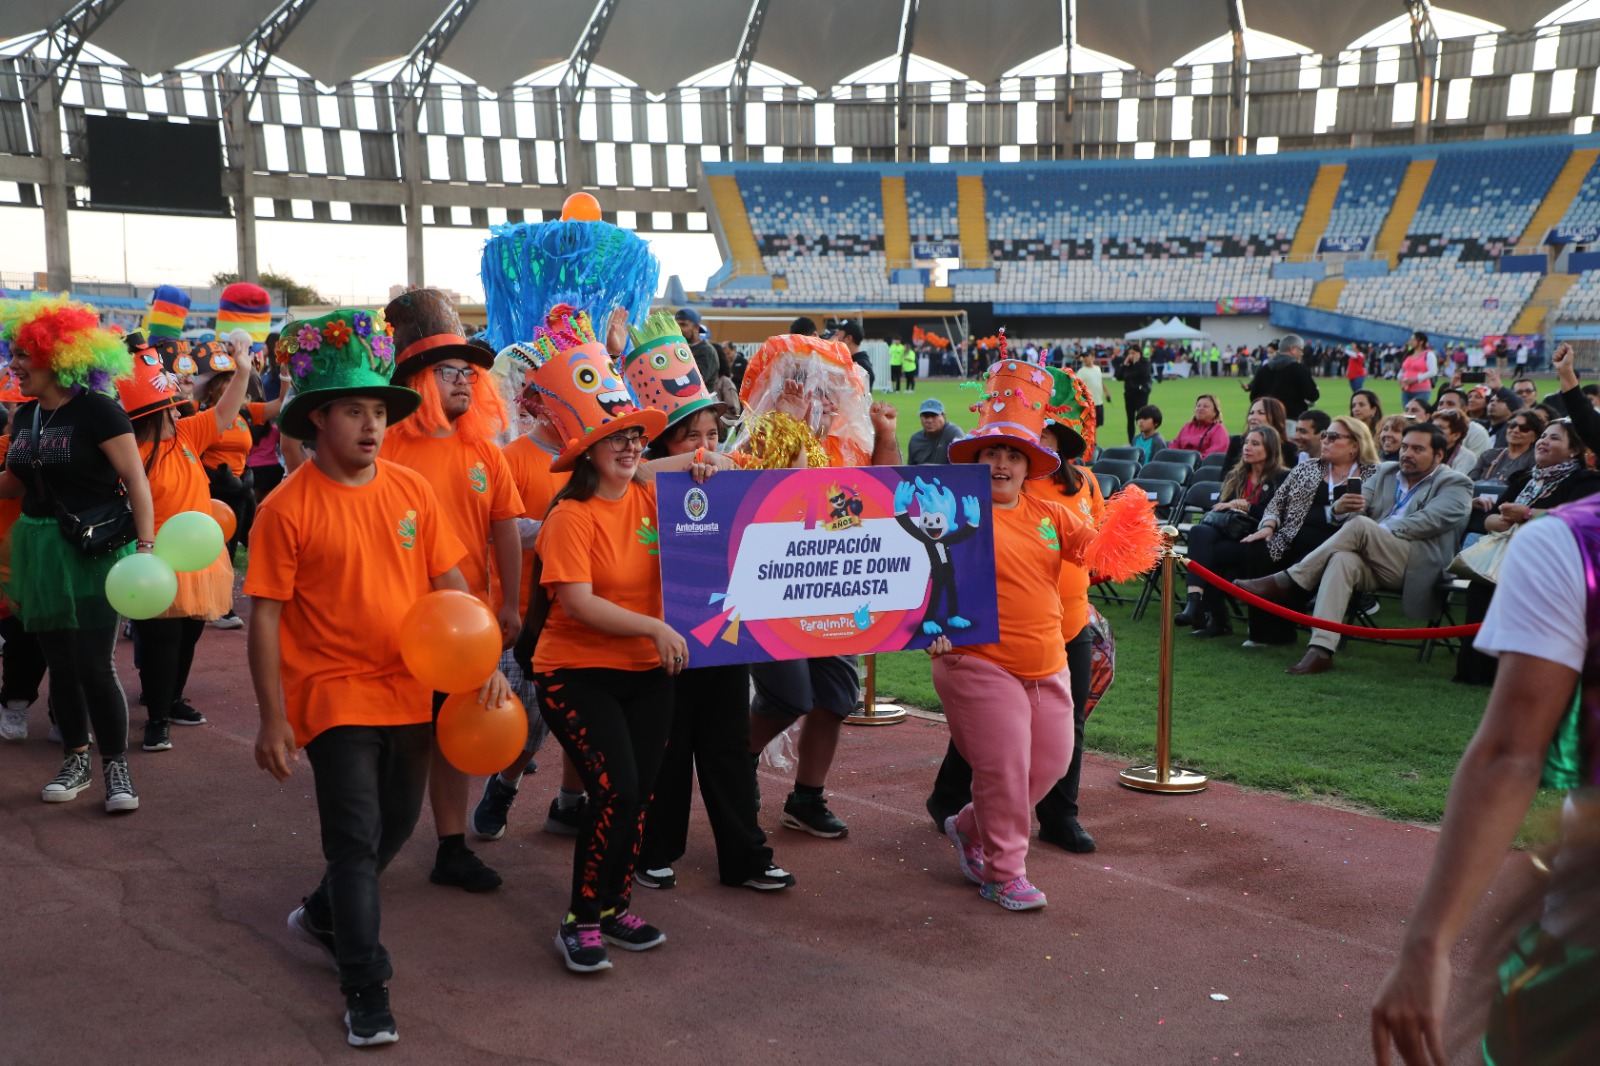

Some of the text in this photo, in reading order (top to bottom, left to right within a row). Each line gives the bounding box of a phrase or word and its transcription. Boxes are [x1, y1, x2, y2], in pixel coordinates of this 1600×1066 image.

[675, 522, 719, 533] Antofagasta
[832, 517, 853, 530] AÑOS
[785, 534, 882, 557] AGRUPACIÓN
[757, 556, 911, 581] SÍNDROME DE DOWN
[783, 579, 889, 601] ANTOFAGASTA
